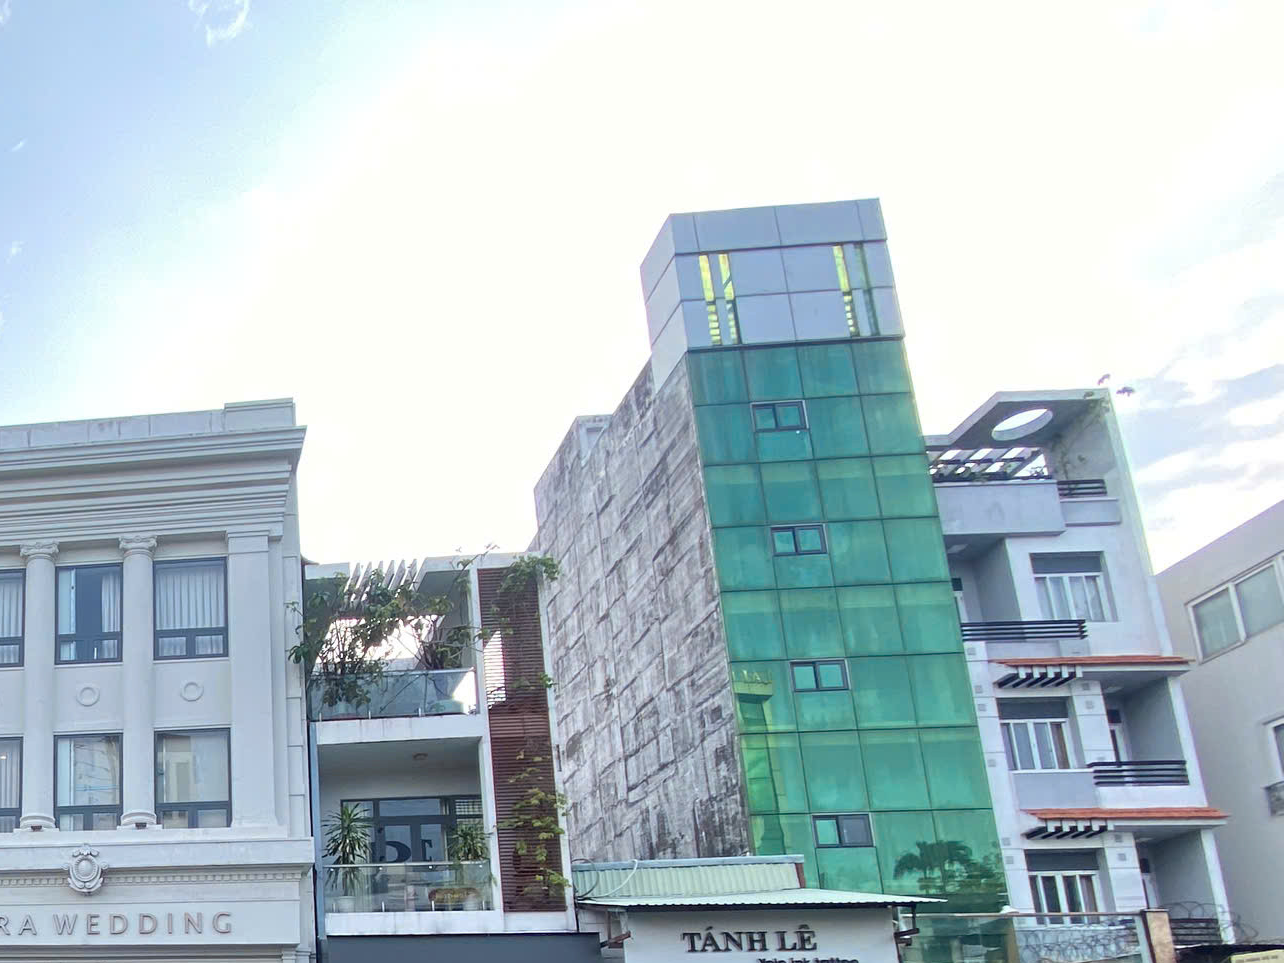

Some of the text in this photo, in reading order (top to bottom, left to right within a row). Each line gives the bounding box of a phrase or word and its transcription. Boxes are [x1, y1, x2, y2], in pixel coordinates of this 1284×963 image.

[53, 912, 232, 935] WEDDING
[683, 924, 817, 953] TÁNH LÊ
